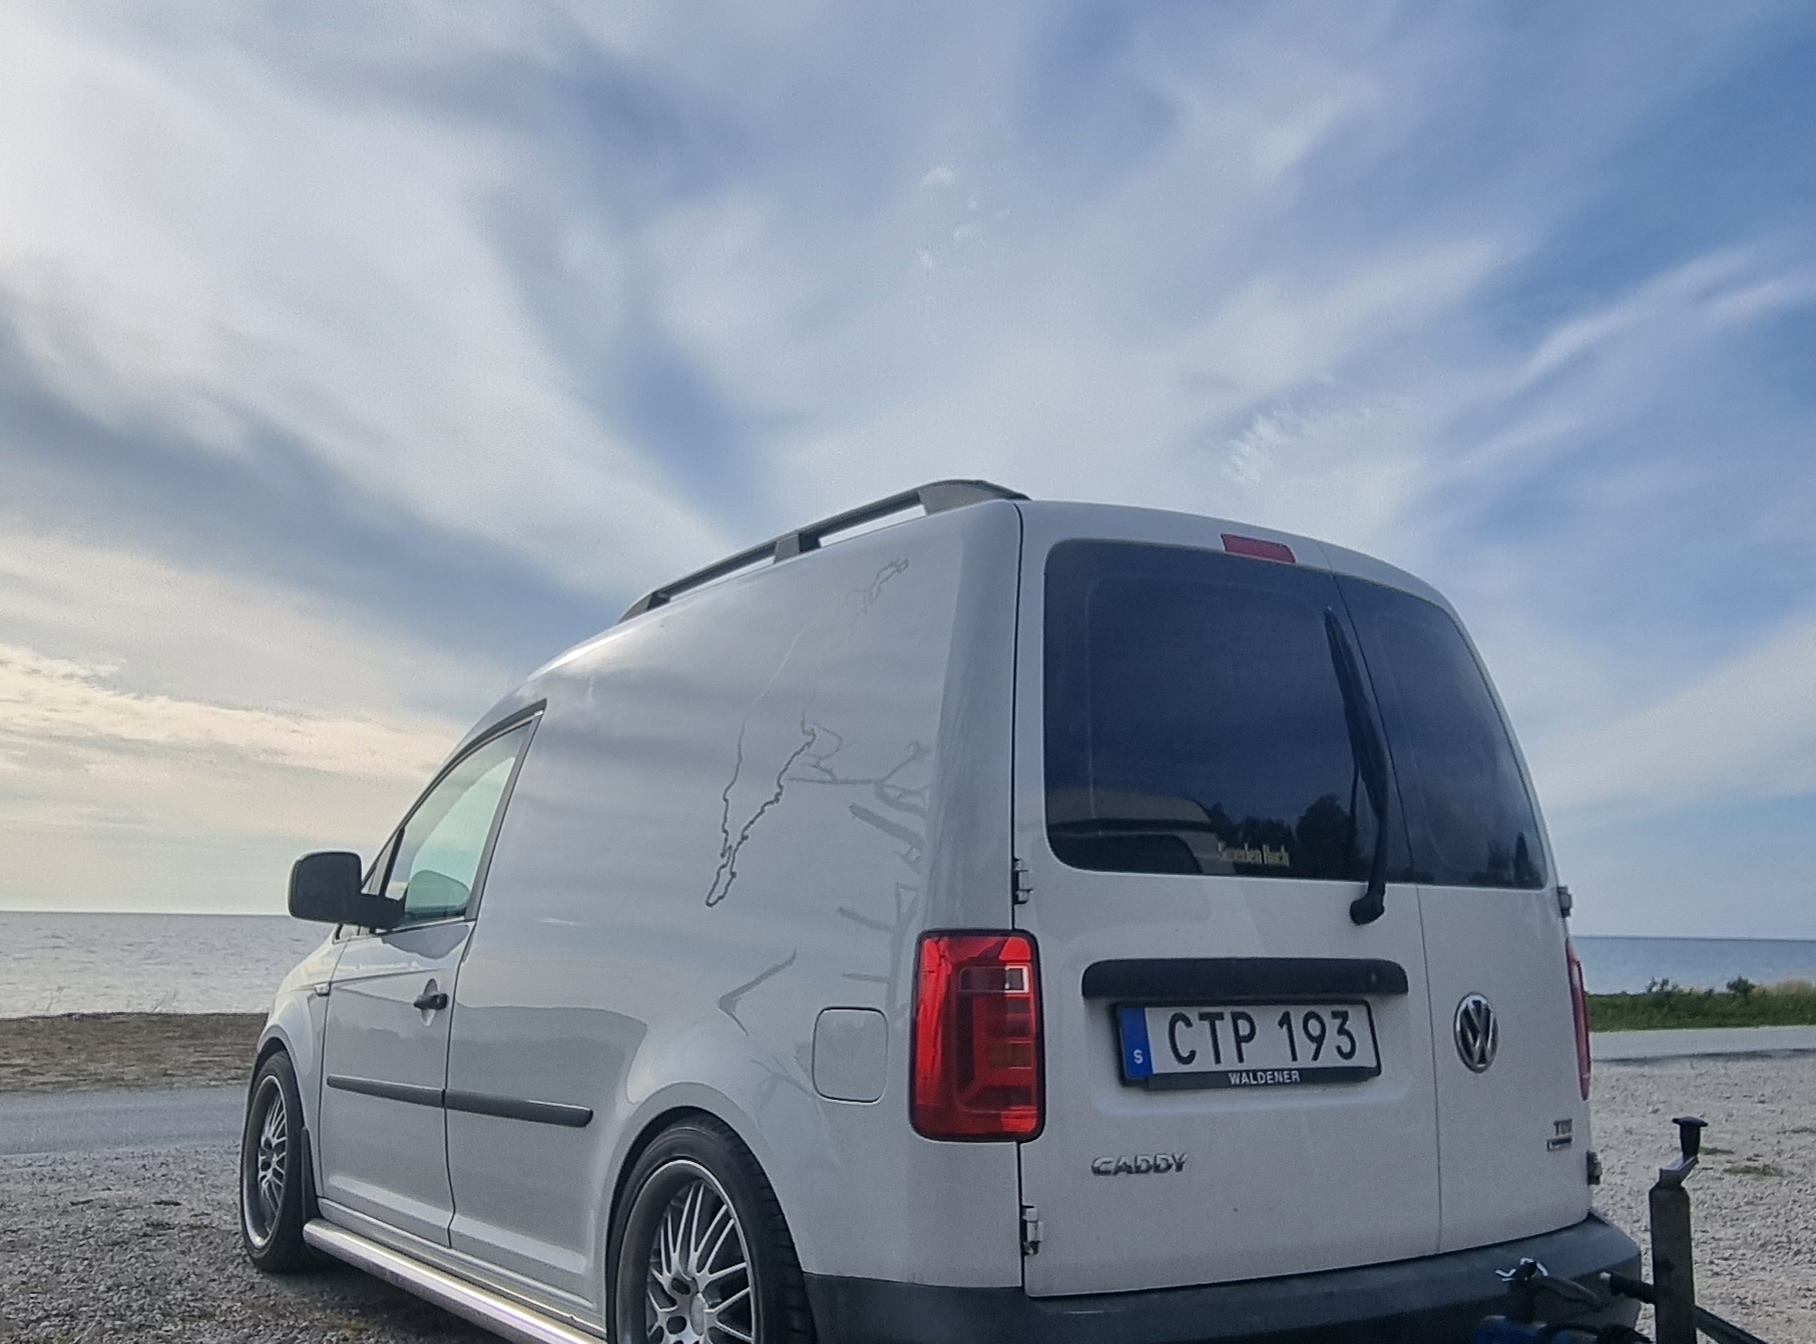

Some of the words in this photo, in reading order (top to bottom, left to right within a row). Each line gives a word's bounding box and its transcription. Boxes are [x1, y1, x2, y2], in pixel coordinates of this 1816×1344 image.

[1168, 1010, 1257, 1066] CTP
[1277, 1010, 1357, 1062] 193
[1133, 1049, 1144, 1064] S
[1228, 1070, 1301, 1086] WALDENER
[1090, 1152, 1188, 1177] CADDY
